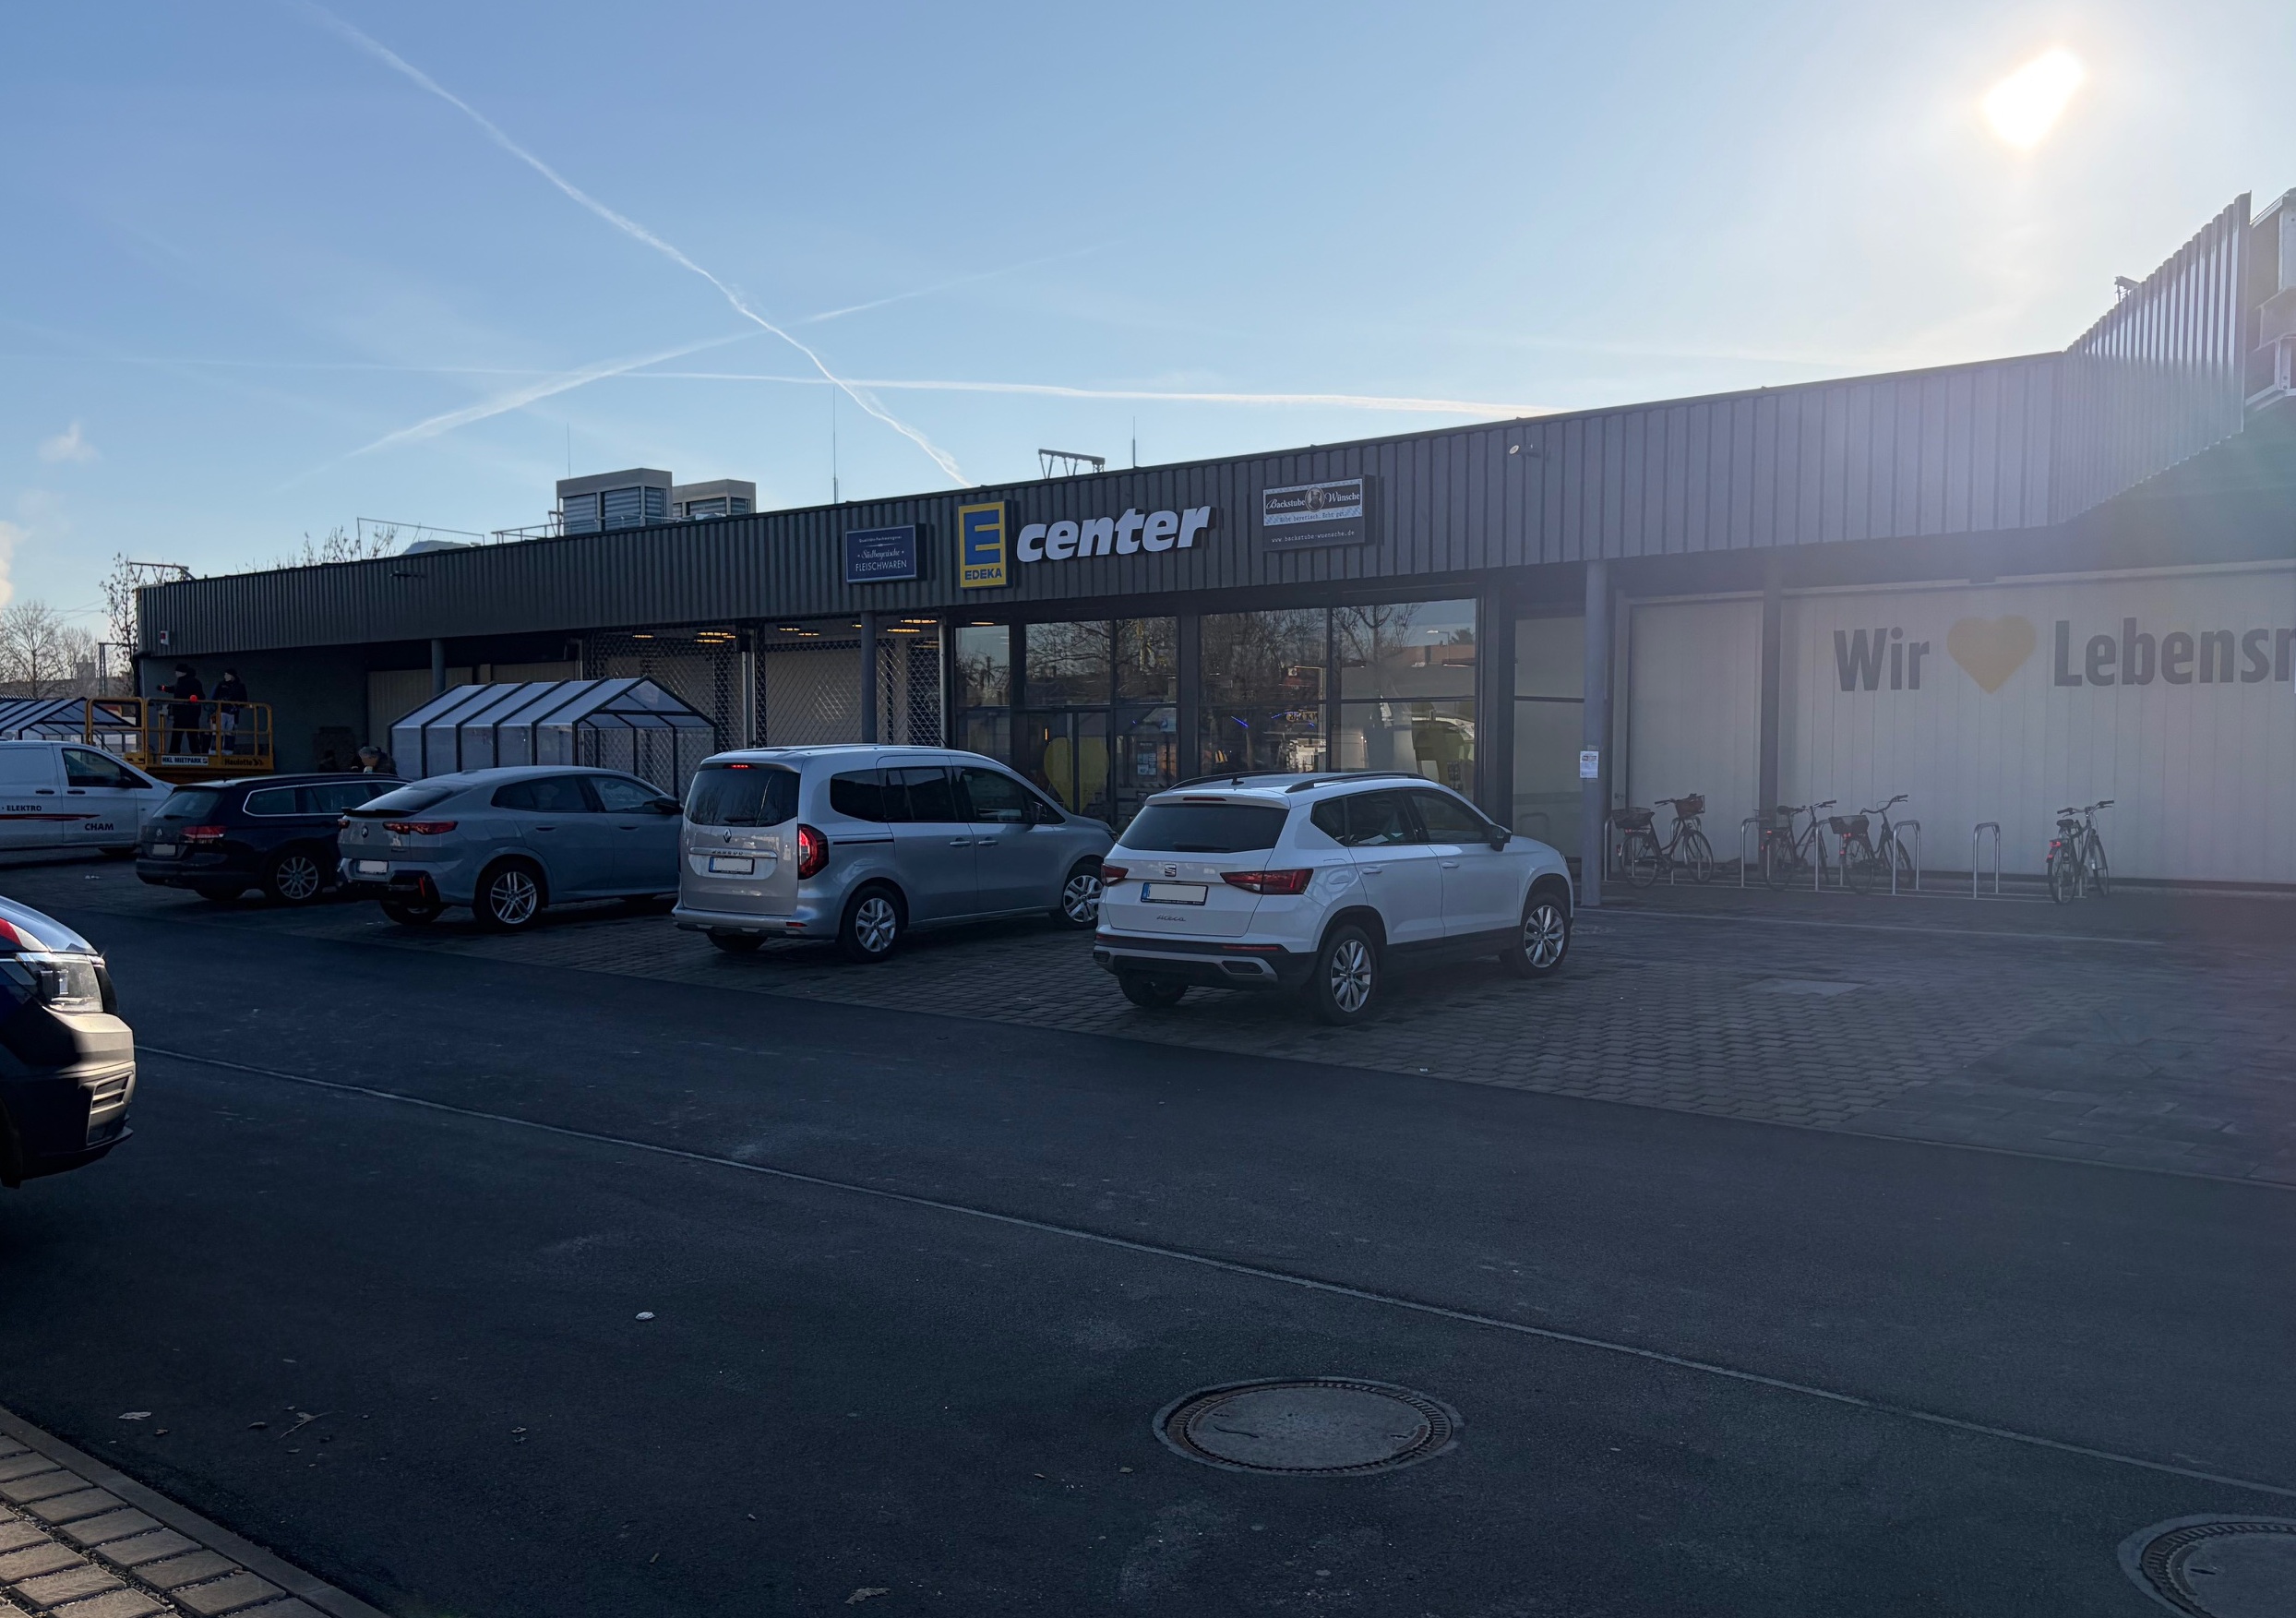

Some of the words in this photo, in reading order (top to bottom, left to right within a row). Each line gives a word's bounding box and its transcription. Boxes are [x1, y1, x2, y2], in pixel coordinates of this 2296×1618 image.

[1266, 498, 1306, 509] Backstube
[1324, 491, 1360, 503] Wünsche
[1016, 506, 1212, 563] center
[1271, 530, 1355, 543] www.backstube-wuensche.de
[855, 559, 907, 572] FLEISCHWAREN
[964, 568, 1002, 581] EDEKA
[1834, 627, 1930, 692] Wir
[84, 822, 114, 831] CHAM
